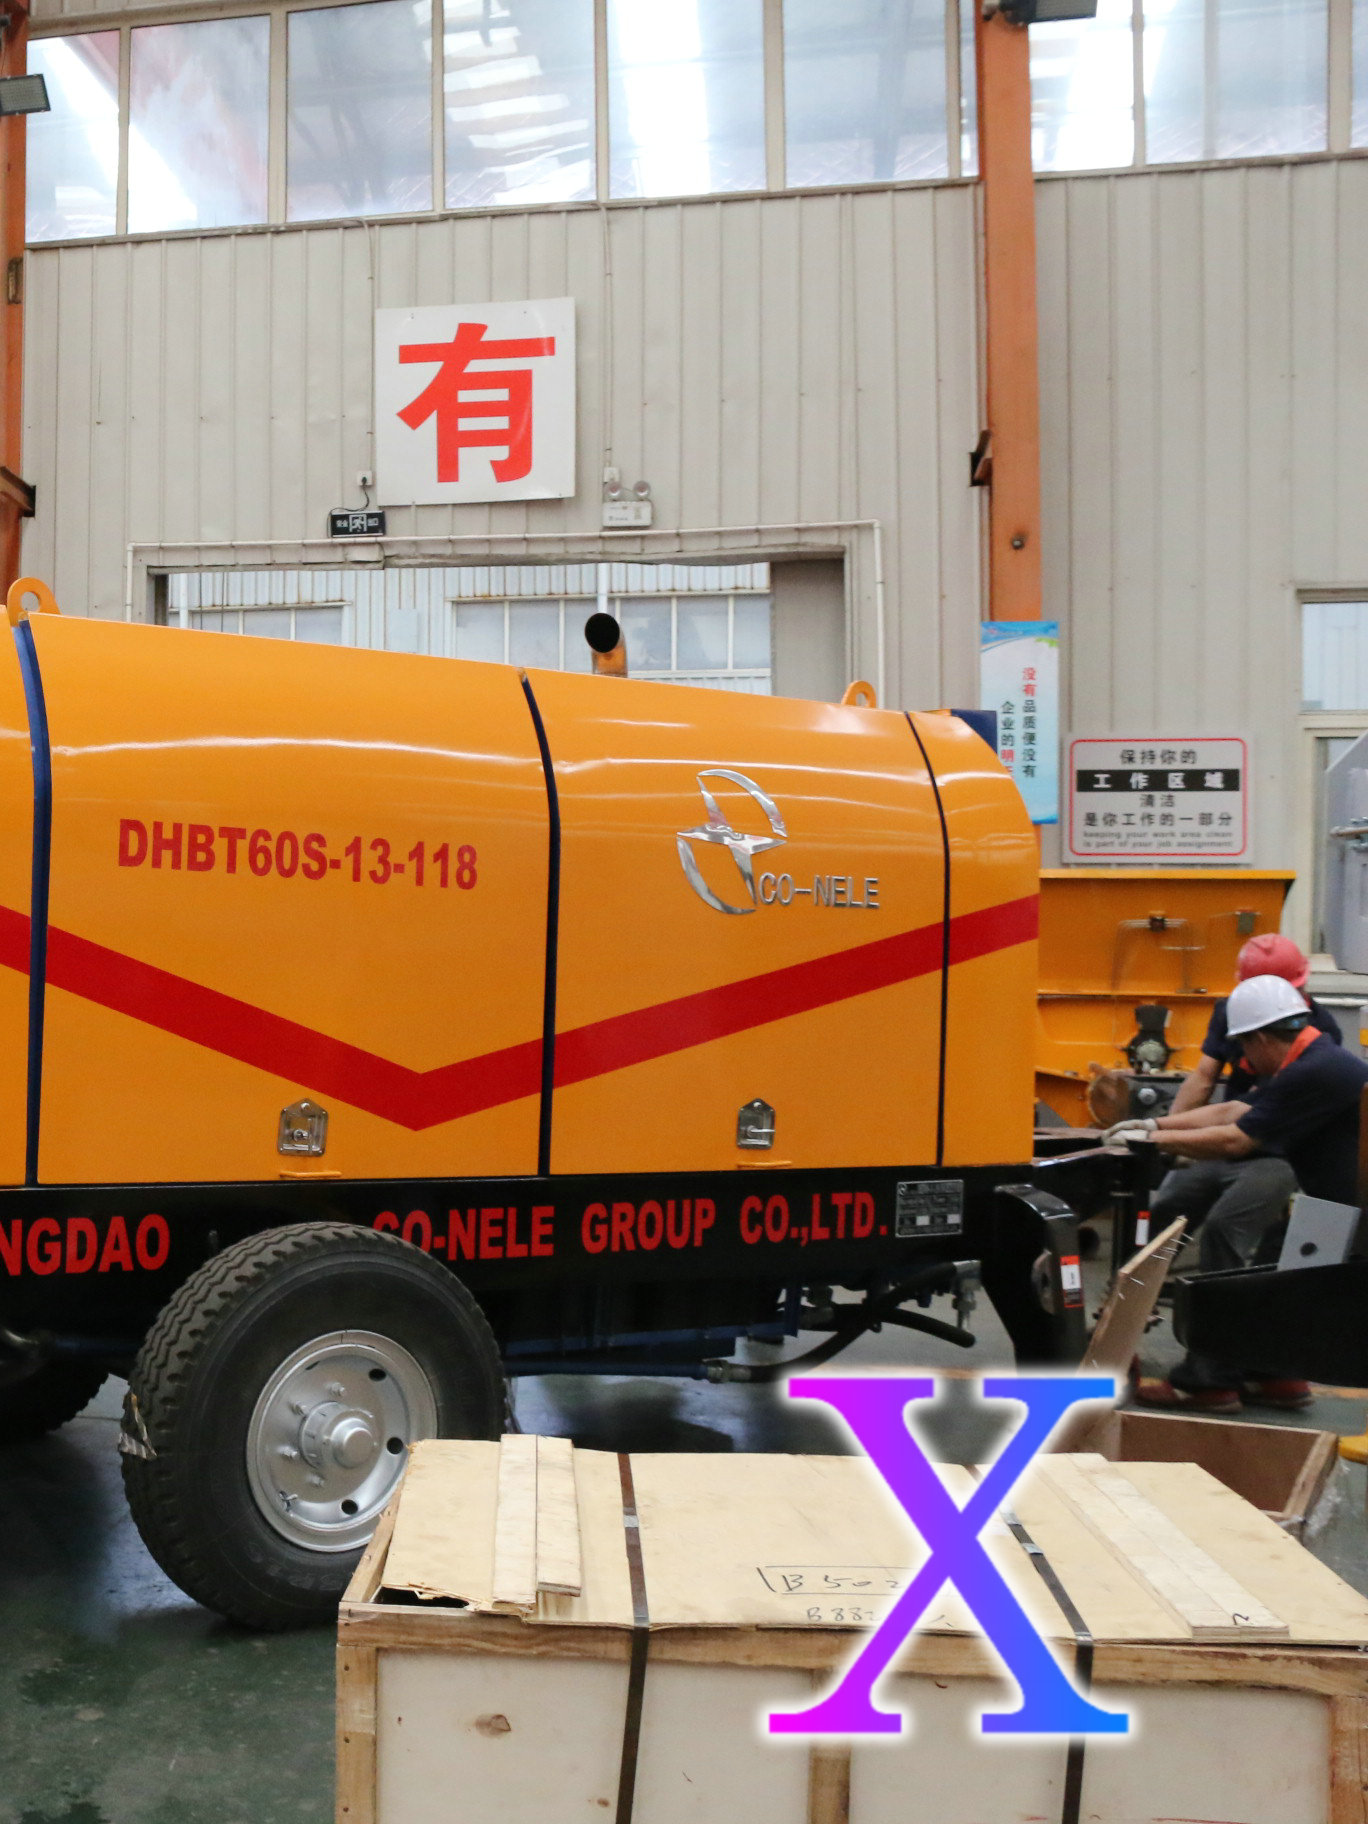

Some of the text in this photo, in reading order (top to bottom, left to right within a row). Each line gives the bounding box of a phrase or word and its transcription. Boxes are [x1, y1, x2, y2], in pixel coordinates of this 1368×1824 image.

[397, 322, 556, 483] 有
[1022, 667, 1037, 778] 没有品质便没有
[1120, 749, 1197, 765] 保持你的
[1084, 812, 1233, 827] 是你工作的一部分
[1139, 793, 1176, 808] 清洁
[118, 818, 478, 890] DHBT60S-13-118
[758, 871, 880, 908] CO-NELE
[581, 1198, 716, 1254] GROUP
[739, 1191, 888, 1246] CO.,LTD.
